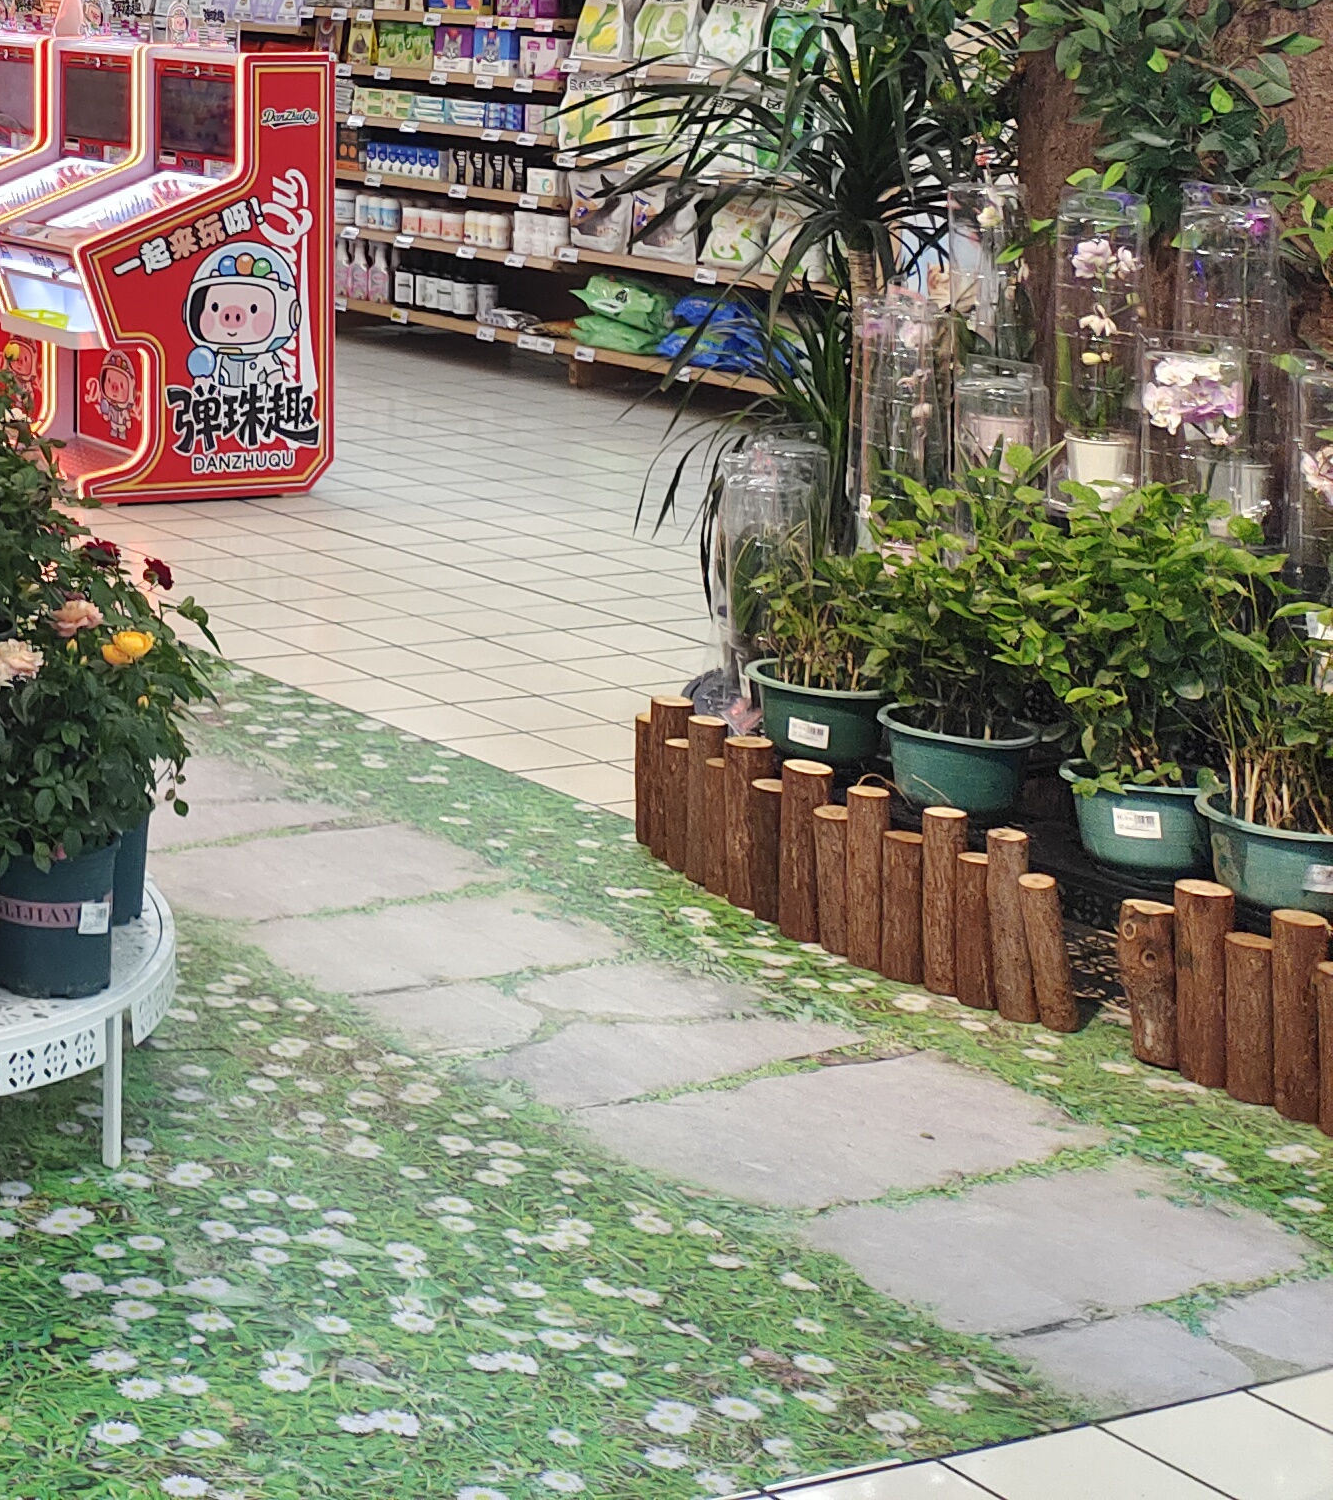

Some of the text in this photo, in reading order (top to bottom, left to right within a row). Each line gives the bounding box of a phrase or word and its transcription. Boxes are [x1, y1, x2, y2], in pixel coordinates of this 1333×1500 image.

[261, 108, 318, 128] DanZhuQu
[113, 196, 264, 276] 一起来玩呀！
[165, 382, 321, 457] 弹珠趣
[191, 450, 297, 474] DANZHUQU
